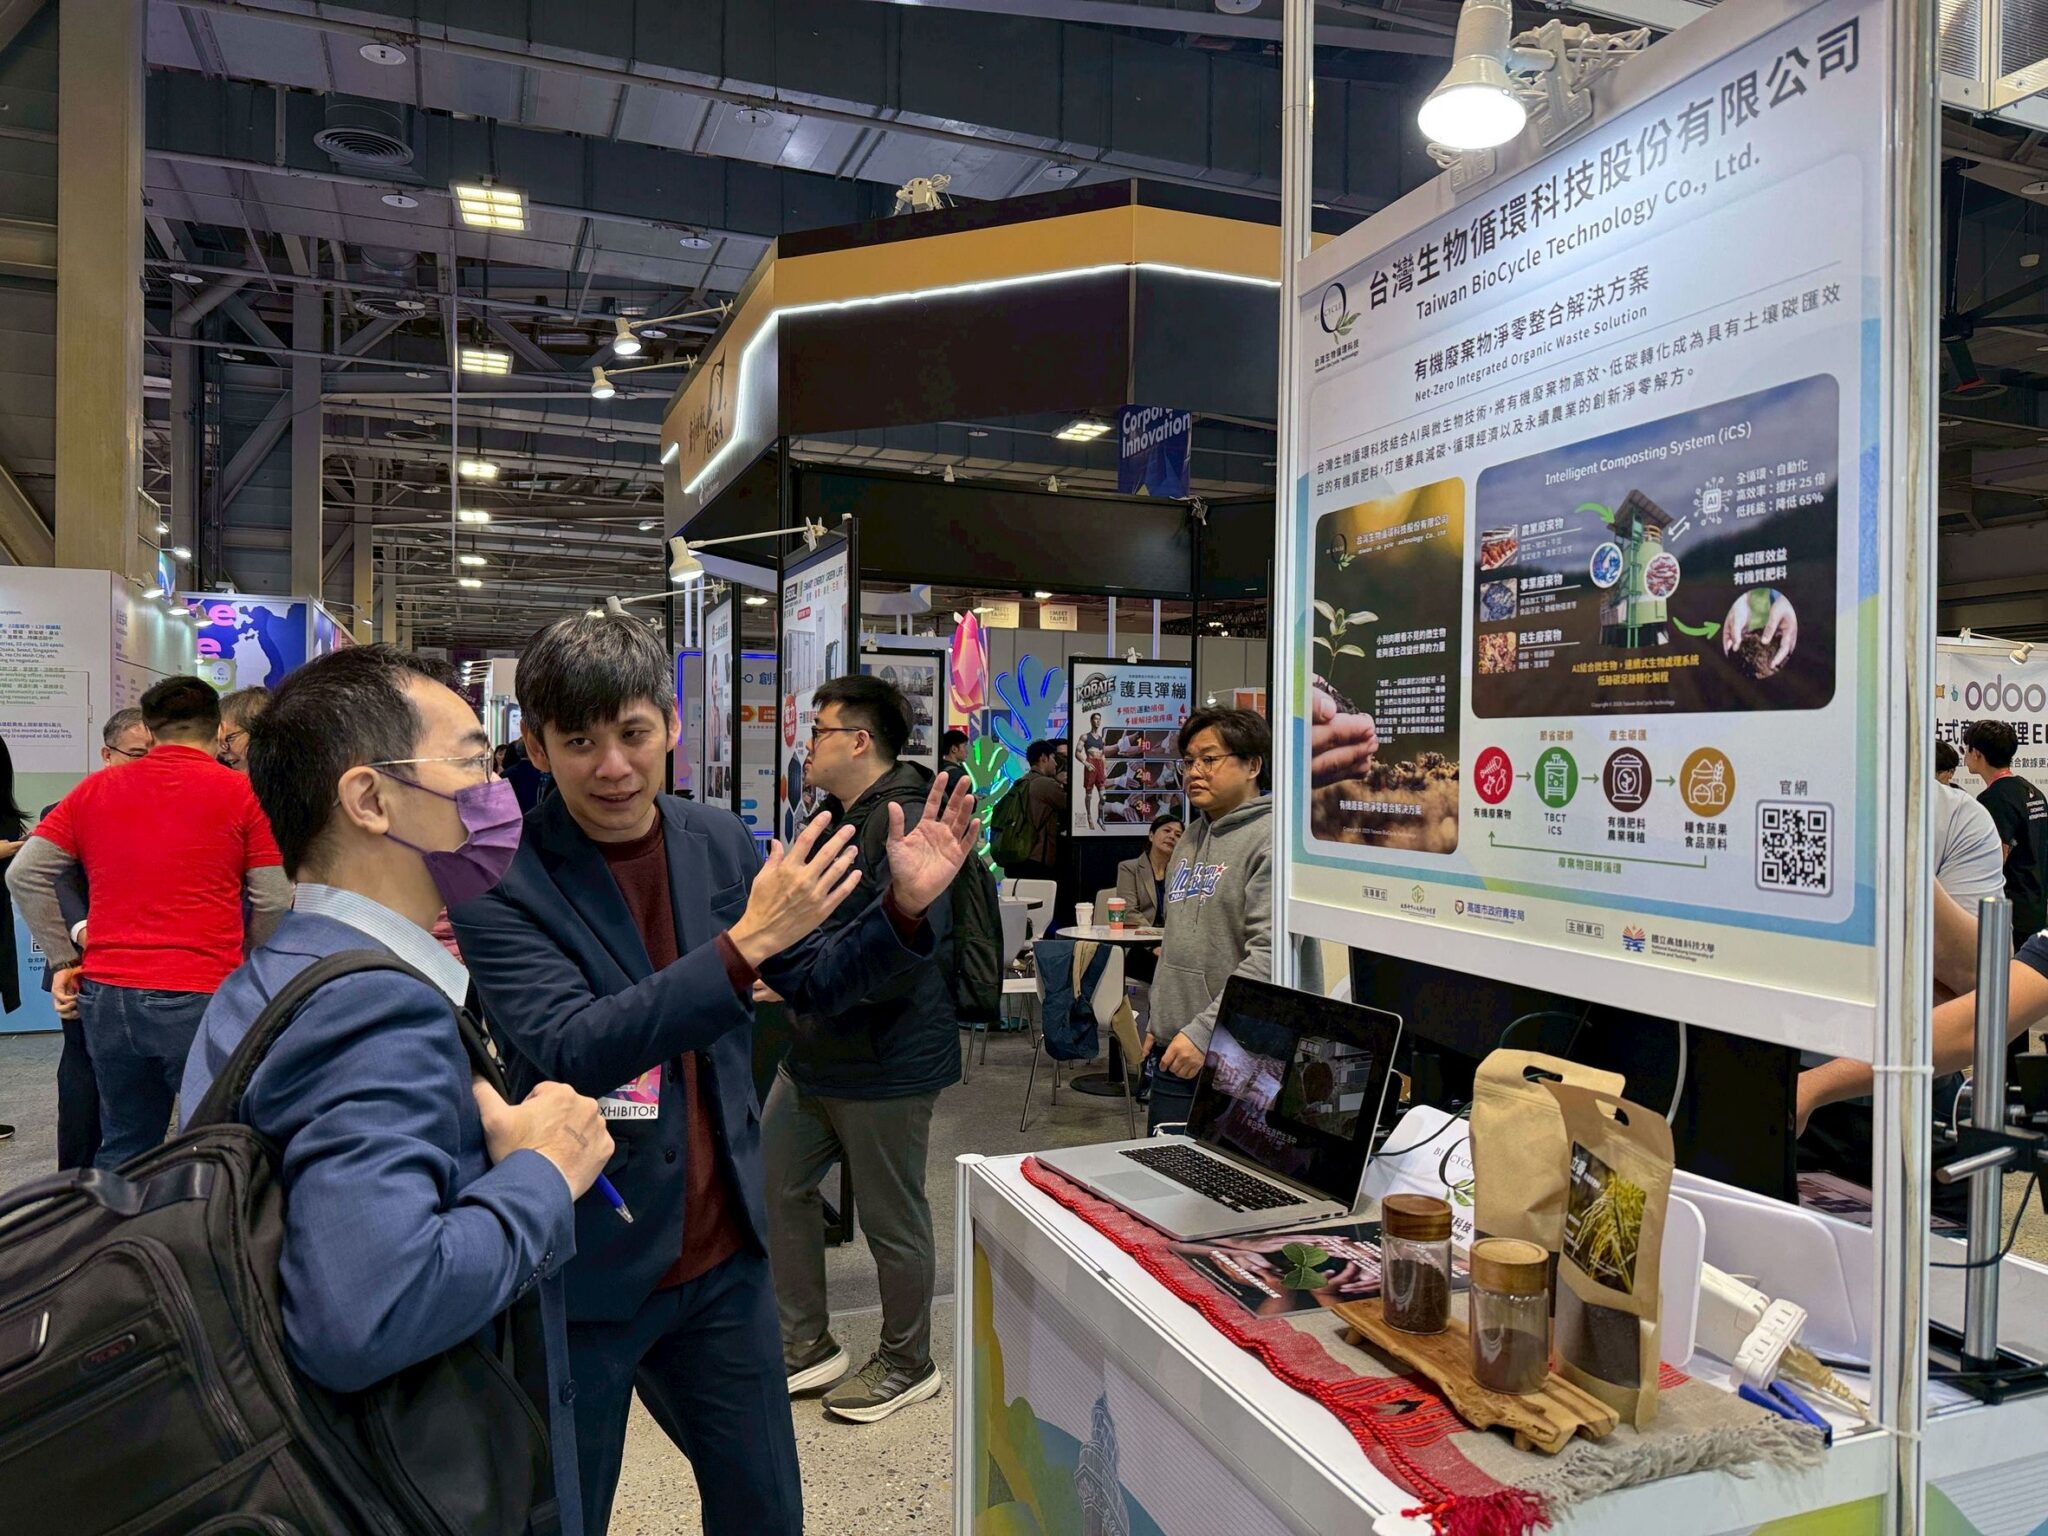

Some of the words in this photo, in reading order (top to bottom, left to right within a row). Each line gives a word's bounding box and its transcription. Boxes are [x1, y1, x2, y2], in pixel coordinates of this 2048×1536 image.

[1369, 15, 1860, 311] 台灣生物循環科技股份有限公司
[1416, 286, 1468, 321] Taiwan
[1472, 249, 1542, 298] BioCycle
[1547, 194, 1657, 263] Technology
[1665, 171, 1708, 207] Co.,
[1714, 143, 1761, 182] Ltd.
[1414, 265, 1649, 382] 有機廢棄物淨零整合解決方案
[1415, 380, 1454, 402] Net-Zero
[1457, 357, 1508, 388] Integrated
[1511, 342, 1553, 366] Organic
[1556, 329, 1590, 348] Waste
[1594, 306, 1648, 335] Solution
[1123, 413, 1190, 458] Innovation
[1545, 461, 1598, 486] Intelligent
[1599, 446, 1669, 477] Composting
[1671, 434, 1713, 463] System
[1717, 421, 1752, 448] (iCS)
[1800, 477, 1812, 489] 25
[1800, 492, 1825, 507] 65%
[1521, 517, 1564, 537] 農業廢棄物
[1734, 547, 1787, 568] 具碳匯效益
[1520, 573, 1563, 591] 事業廢棄物
[1734, 565, 1787, 585] 有機質肥料
[1519, 628, 1562, 646] 民生廢棄物
[1965, 674, 2046, 713] odoo
[1780, 779, 1808, 796] 官網
[1473, 807, 1511, 820] 有機廢棄物
[1544, 812, 1567, 823] TBCT
[1607, 816, 1646, 830] 有機肥料
[1684, 821, 1728, 836] 糧食蔬果
[1607, 829, 1646, 844] 農業種植
[1684, 835, 1728, 851] 食品原料
[1467, 901, 1525, 922] 高雄市政府青年局
[1568, 921, 1602, 938] 主辦單位
[1651, 933, 1715, 953] 國立高雄科技大學
[600, 1105, 656, 1117] XHIBITOR
